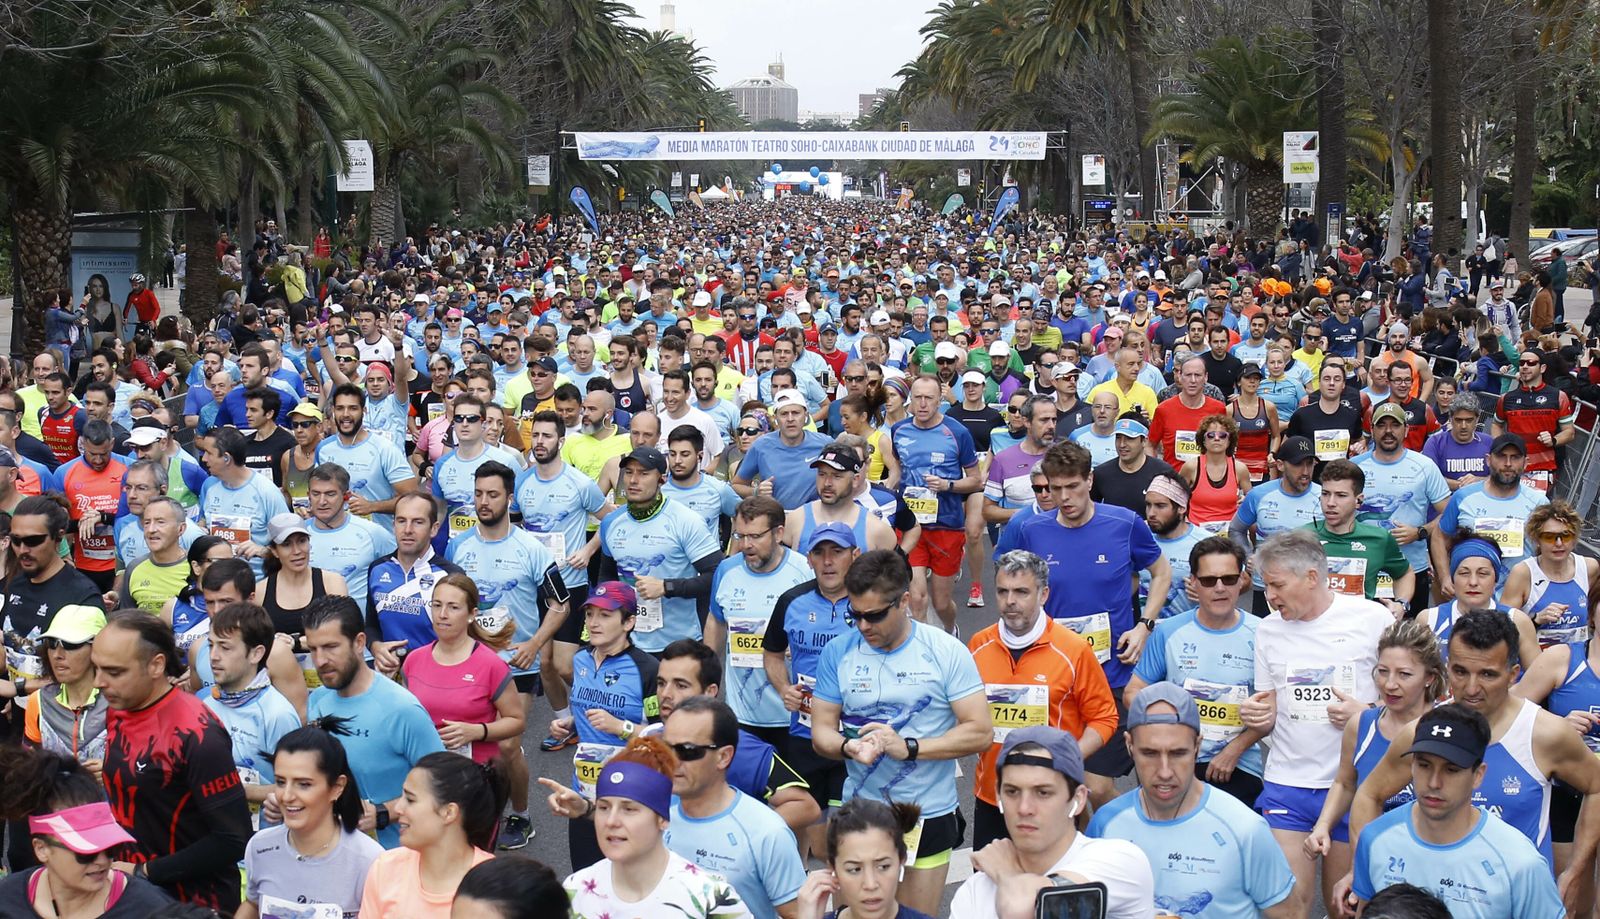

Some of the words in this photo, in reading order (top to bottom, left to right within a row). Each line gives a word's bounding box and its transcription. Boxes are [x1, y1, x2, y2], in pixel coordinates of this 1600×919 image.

[668, 140, 698, 153] MEDIA
[701, 137, 748, 153] MARATÓN
[751, 140, 788, 153] TEATRO
[791, 140, 878, 153] SOHO-CAIXABANK
[881, 140, 917, 153] CIUDAD
[920, 140, 932, 153] DE
[937, 137, 975, 153] MÁLAGA
[1446, 459, 1485, 472] TOULOUSE
[456, 518, 477, 528] 6617
[214, 530, 236, 541] 4868
[737, 637, 764, 649] 6627
[1294, 688, 1331, 701] 9323
[994, 707, 1028, 722] 7174
[1168, 852, 1182, 862] edp
[1440, 878, 1454, 888] edp
